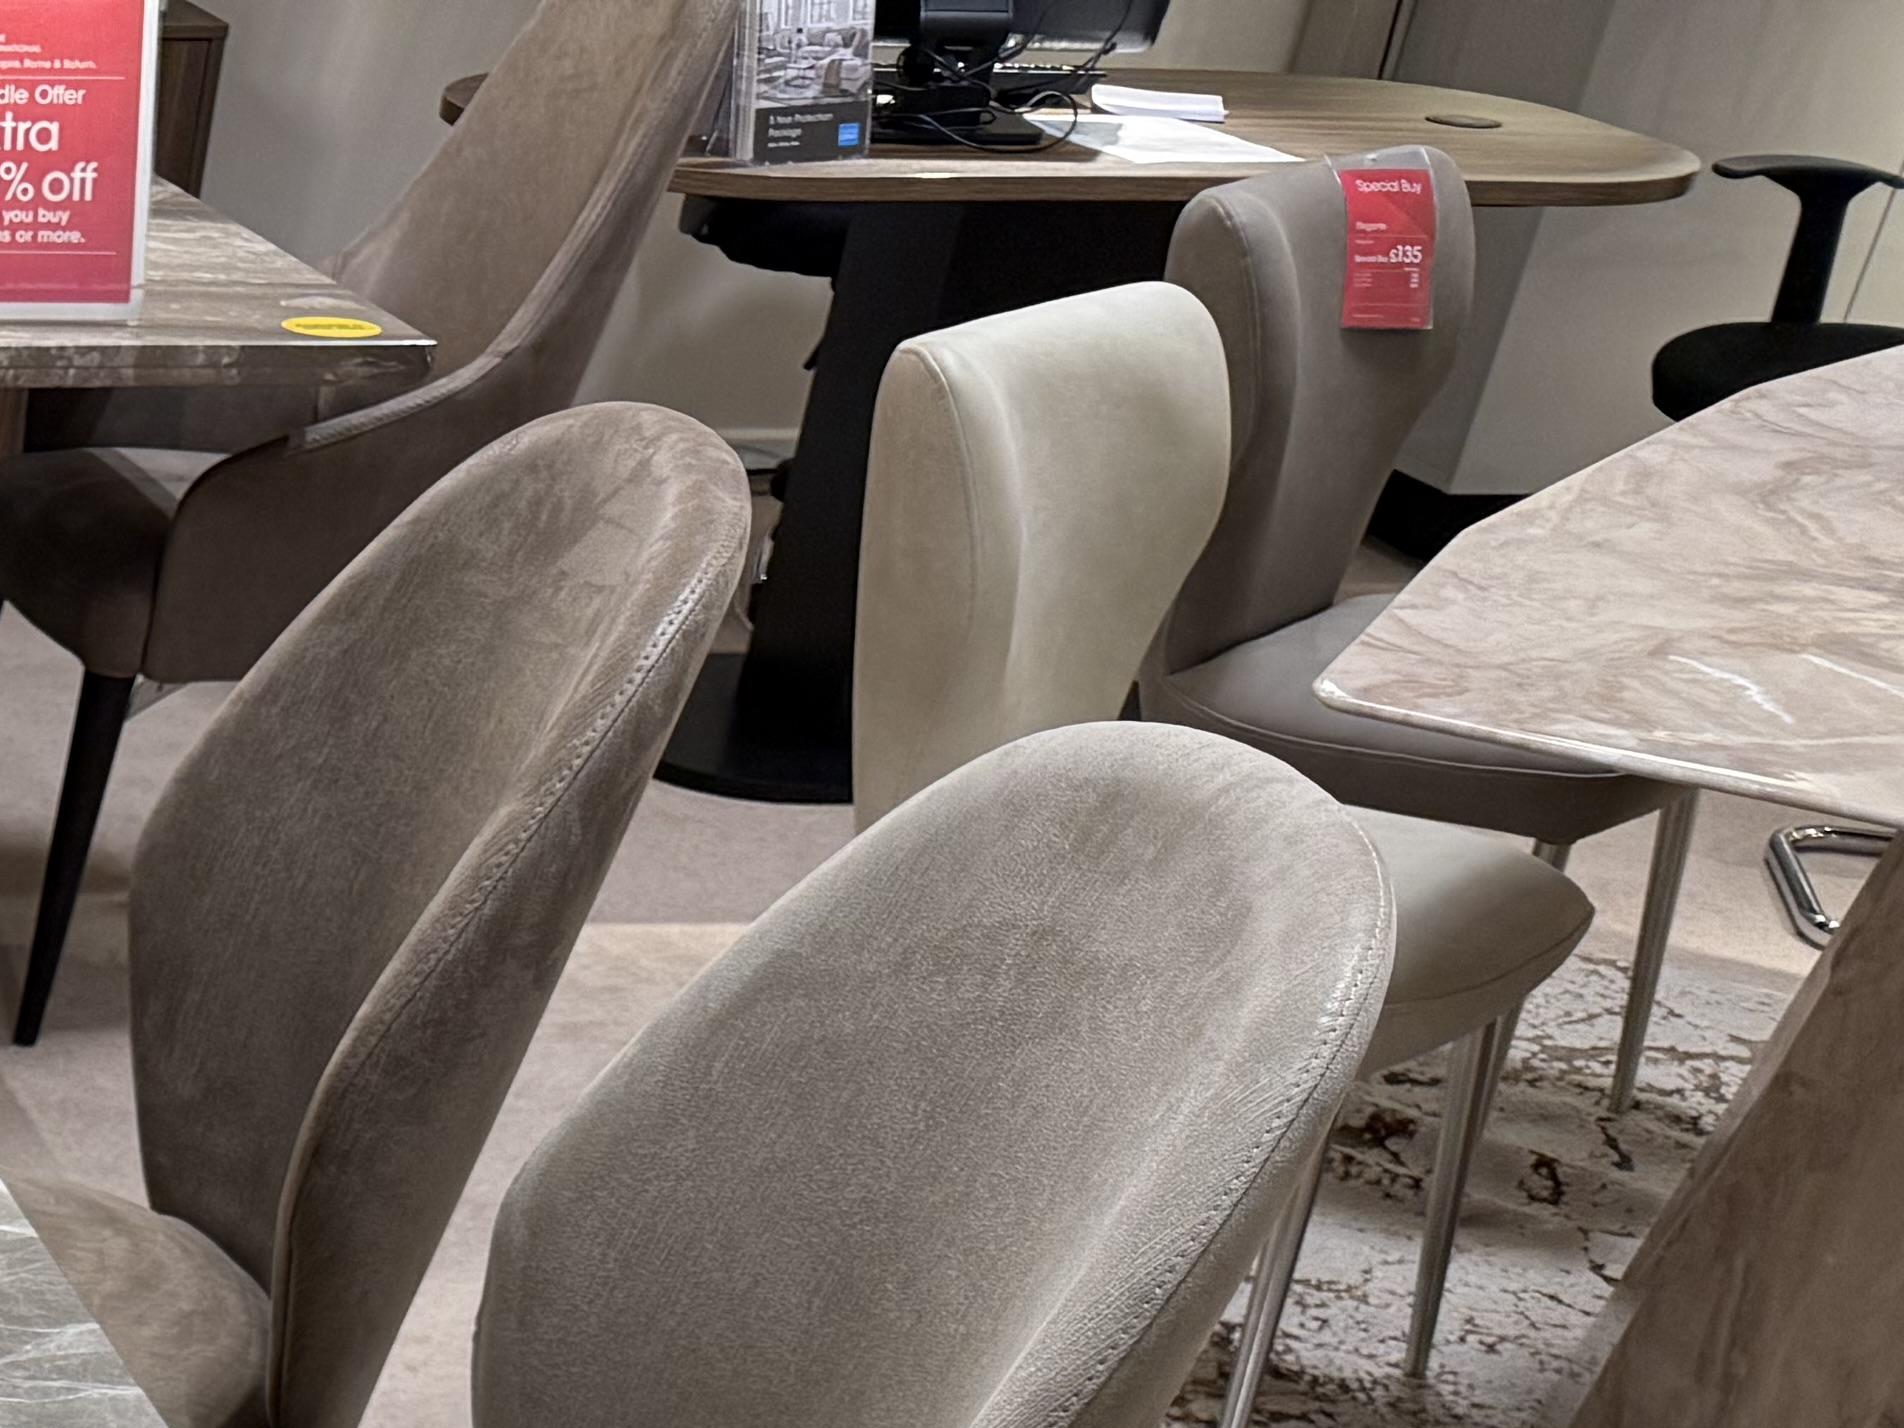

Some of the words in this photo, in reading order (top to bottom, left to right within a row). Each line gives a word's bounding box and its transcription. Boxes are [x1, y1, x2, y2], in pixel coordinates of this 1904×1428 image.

[35, 85, 85, 104] Offer
[42, 161, 98, 202] off
[1356, 180, 1400, 192] Special
[1401, 179, 1421, 193] Buy
[2, 210, 33, 225] you
[38, 208, 70, 225] buy
[15, 231, 33, 243] or
[37, 230, 85, 243] more.
[1389, 245, 1422, 263] £135
